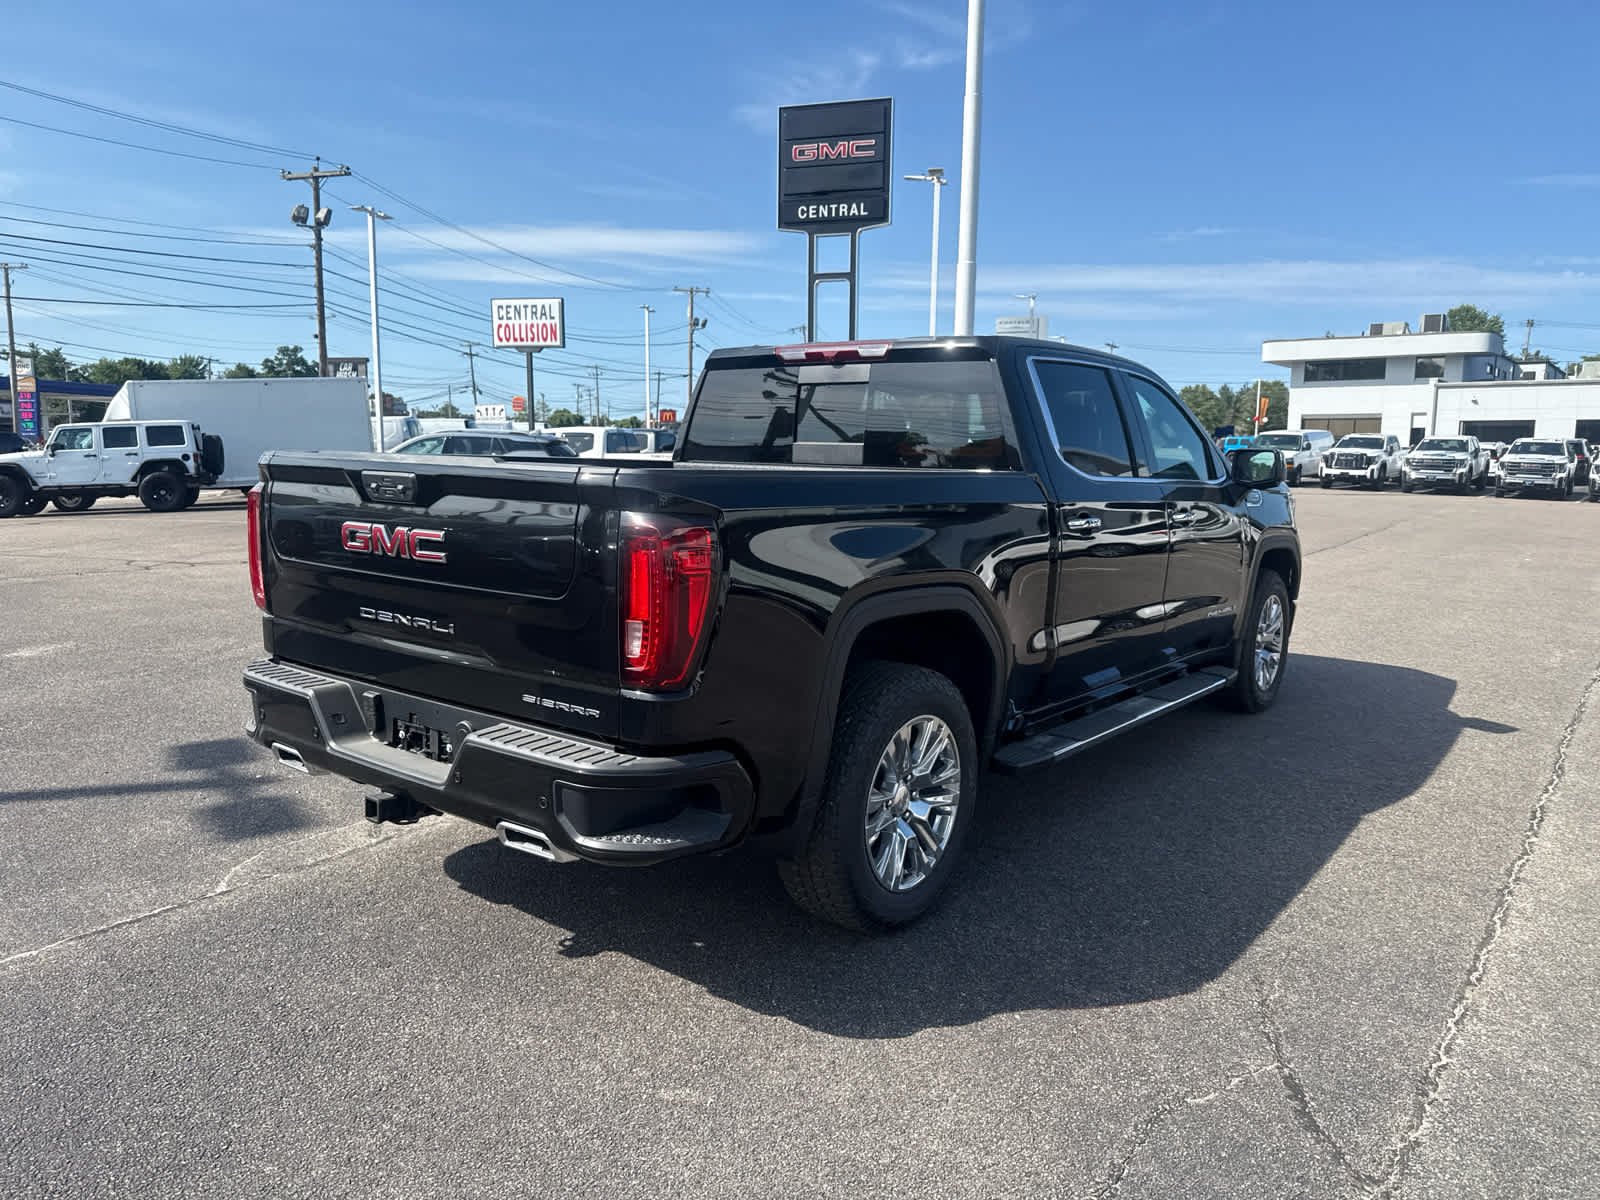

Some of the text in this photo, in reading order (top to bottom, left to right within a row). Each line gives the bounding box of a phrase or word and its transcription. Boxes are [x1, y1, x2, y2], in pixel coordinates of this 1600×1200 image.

[792, 139, 875, 161] GMC
[798, 202, 868, 219] CENTRAL
[497, 304, 555, 321] CENTRAL
[496, 322, 557, 343] COLLISION
[341, 521, 448, 564] GMC
[359, 606, 455, 635] DENALI
[521, 693, 601, 719] SIERRA
